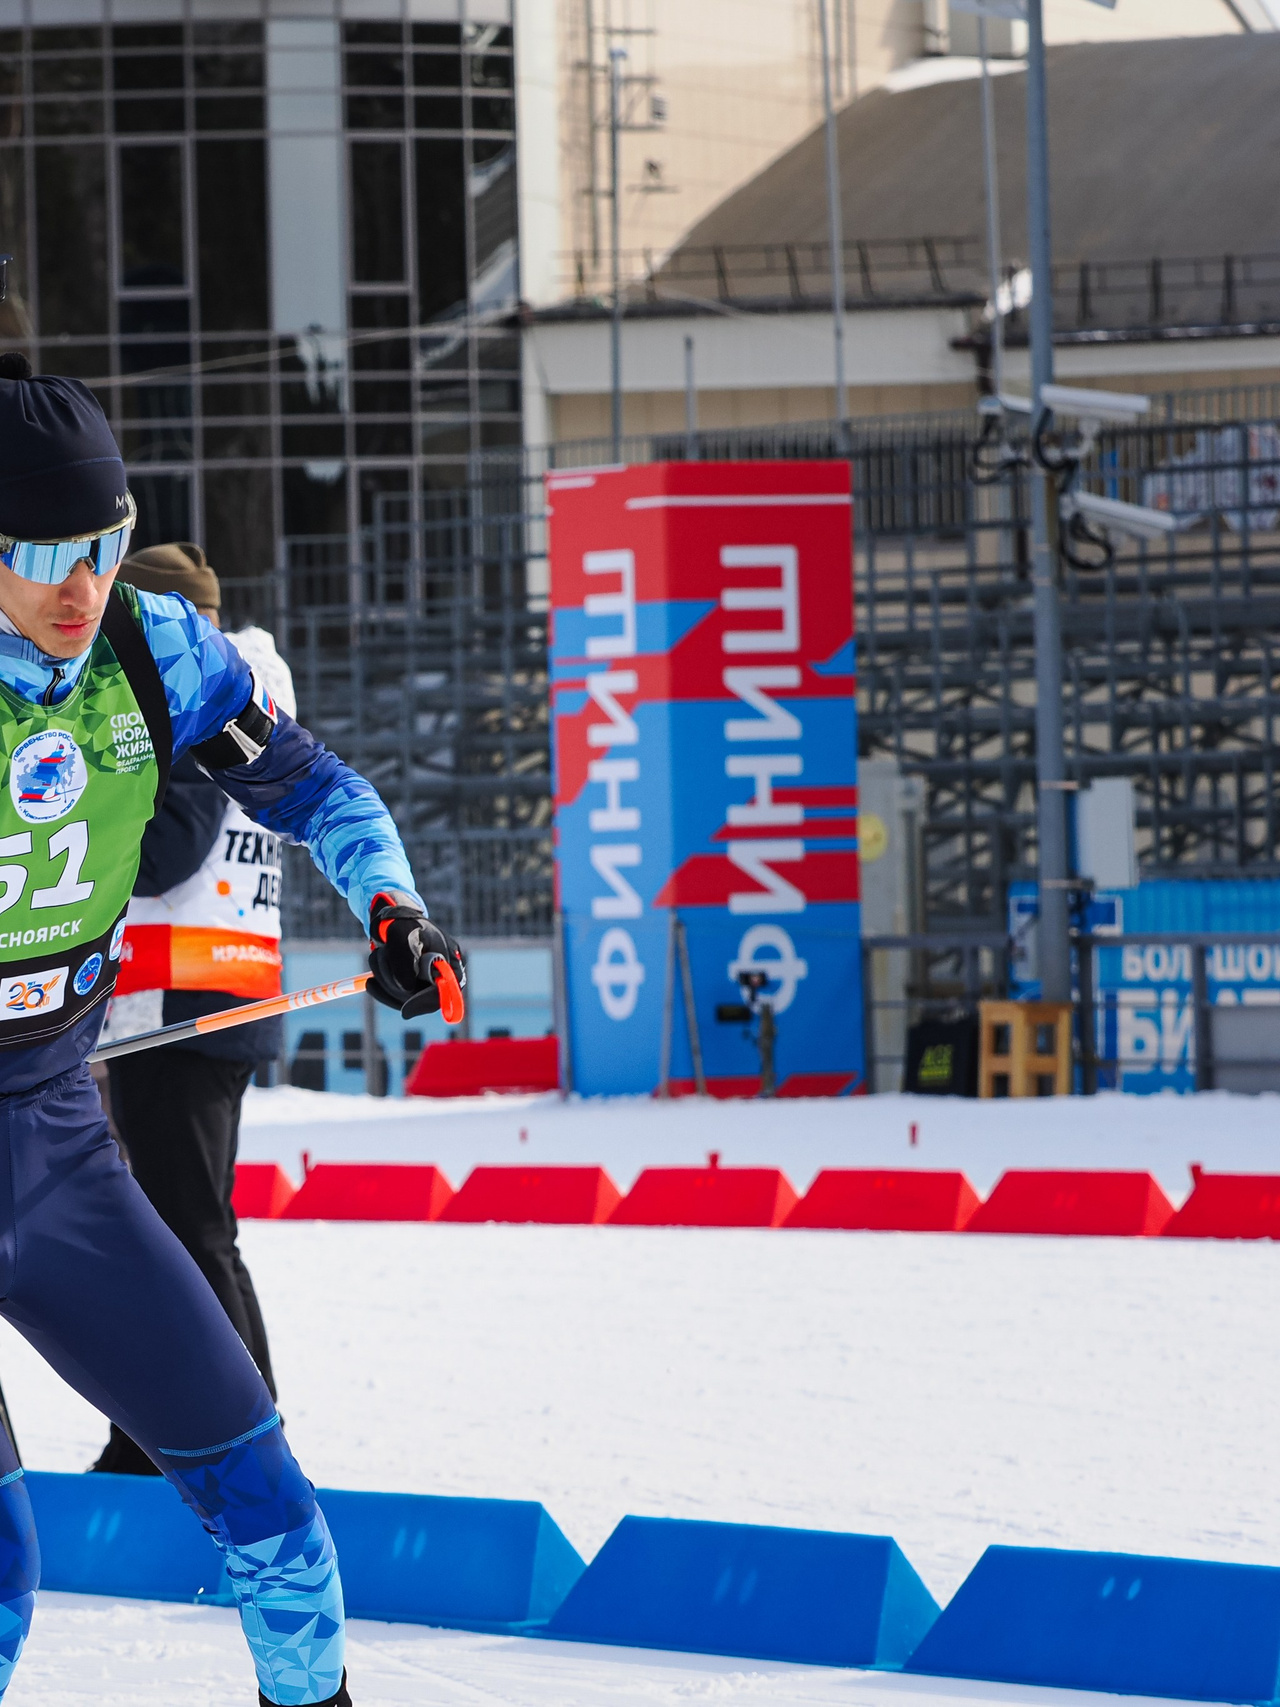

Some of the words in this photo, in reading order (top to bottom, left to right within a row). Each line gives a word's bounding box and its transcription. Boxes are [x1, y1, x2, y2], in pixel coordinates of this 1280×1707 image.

[14, 732, 57, 761] ПЕРВЕНСТВО
[116, 764, 139, 775] ПРОЕКТ
[583, 548, 645, 1020] ФИНИШ
[720, 544, 808, 1015] ФИНИШ
[1122, 944, 1280, 982] БОЛШО
